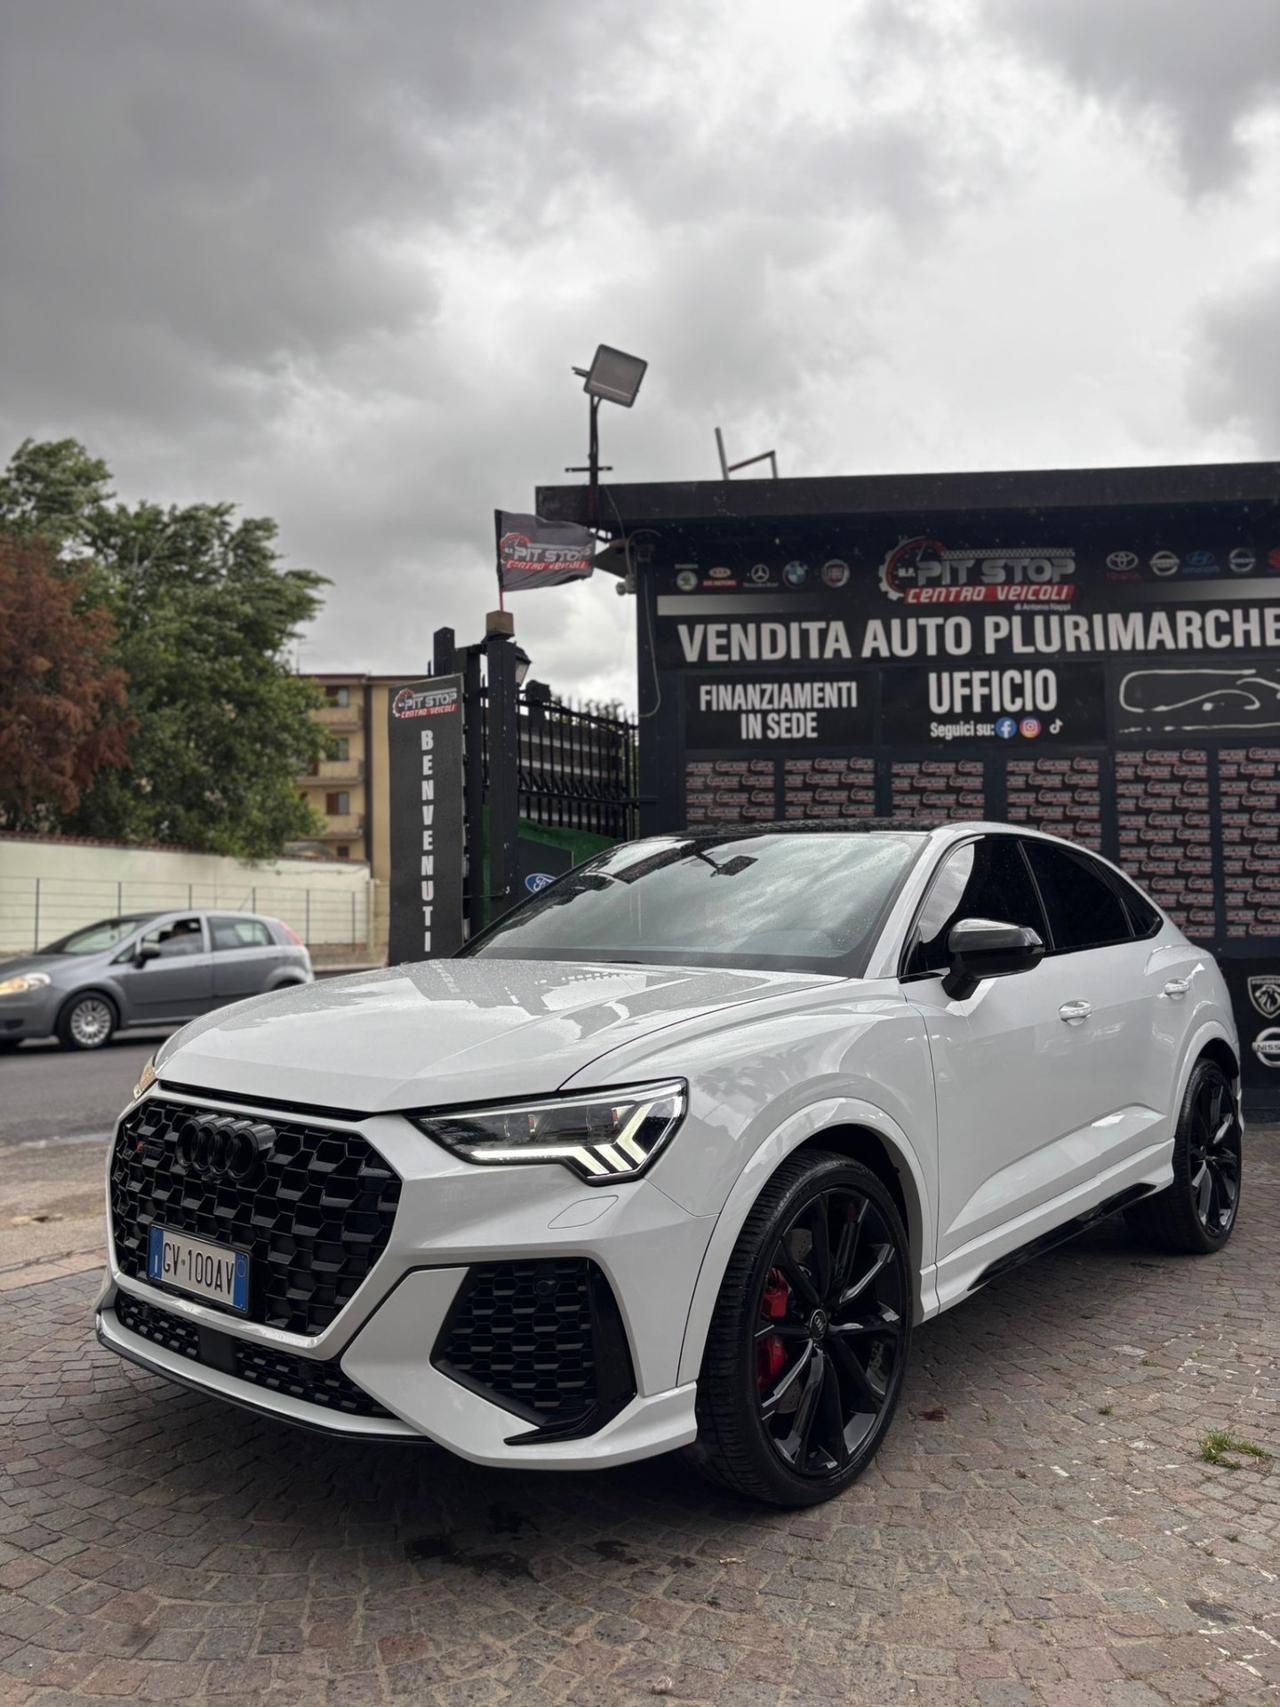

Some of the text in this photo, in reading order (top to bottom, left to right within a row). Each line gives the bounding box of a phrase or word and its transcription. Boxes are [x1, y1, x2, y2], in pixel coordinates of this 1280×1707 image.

[514, 545, 540, 561] PIT
[917, 558, 1076, 586] PIT STOP
[678, 607, 1280, 662] VENDITA AUTO PLURIMARCHE
[404, 692, 457, 710] PIT STOP
[700, 681, 858, 712] FINANZIAMENTI
[928, 669, 1058, 714] UFFICIO
[741, 711, 818, 740] IN SEDE
[930, 720, 974, 741] Seguici
[976, 722, 995, 737] su:
[420, 730, 435, 952] BENVENUTI
